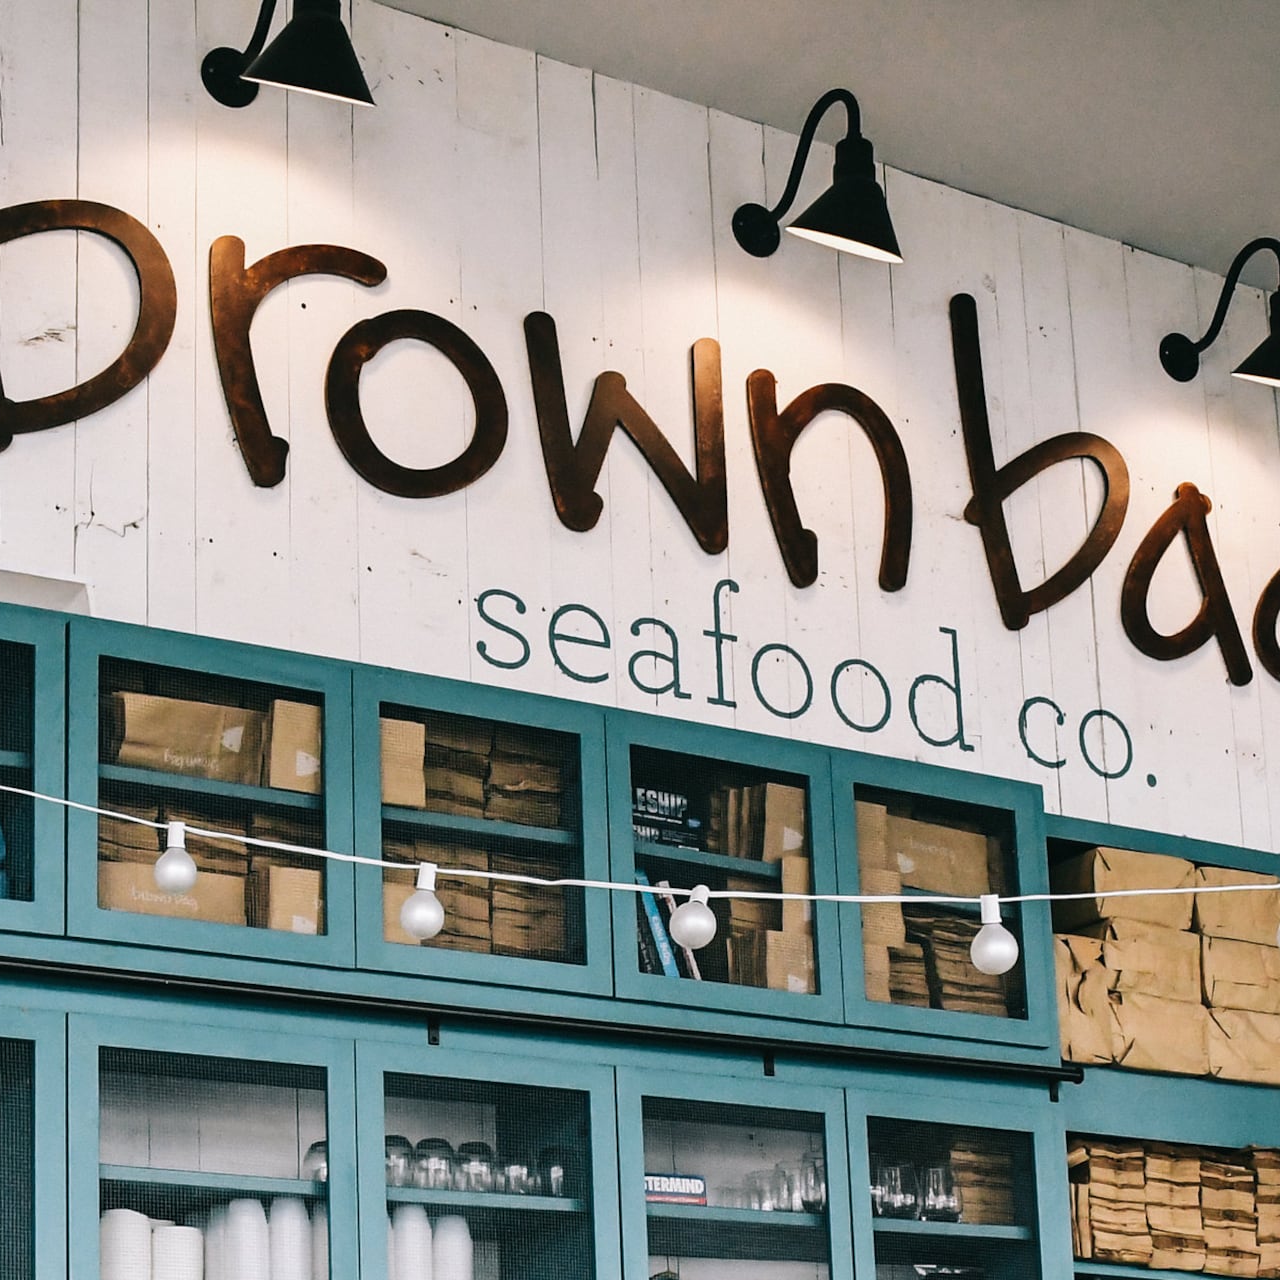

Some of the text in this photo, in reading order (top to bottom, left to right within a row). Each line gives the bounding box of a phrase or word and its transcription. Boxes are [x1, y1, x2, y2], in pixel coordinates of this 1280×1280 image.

[476, 579, 1159, 790] seafood co.
[633, 787, 687, 818] ESHIP
